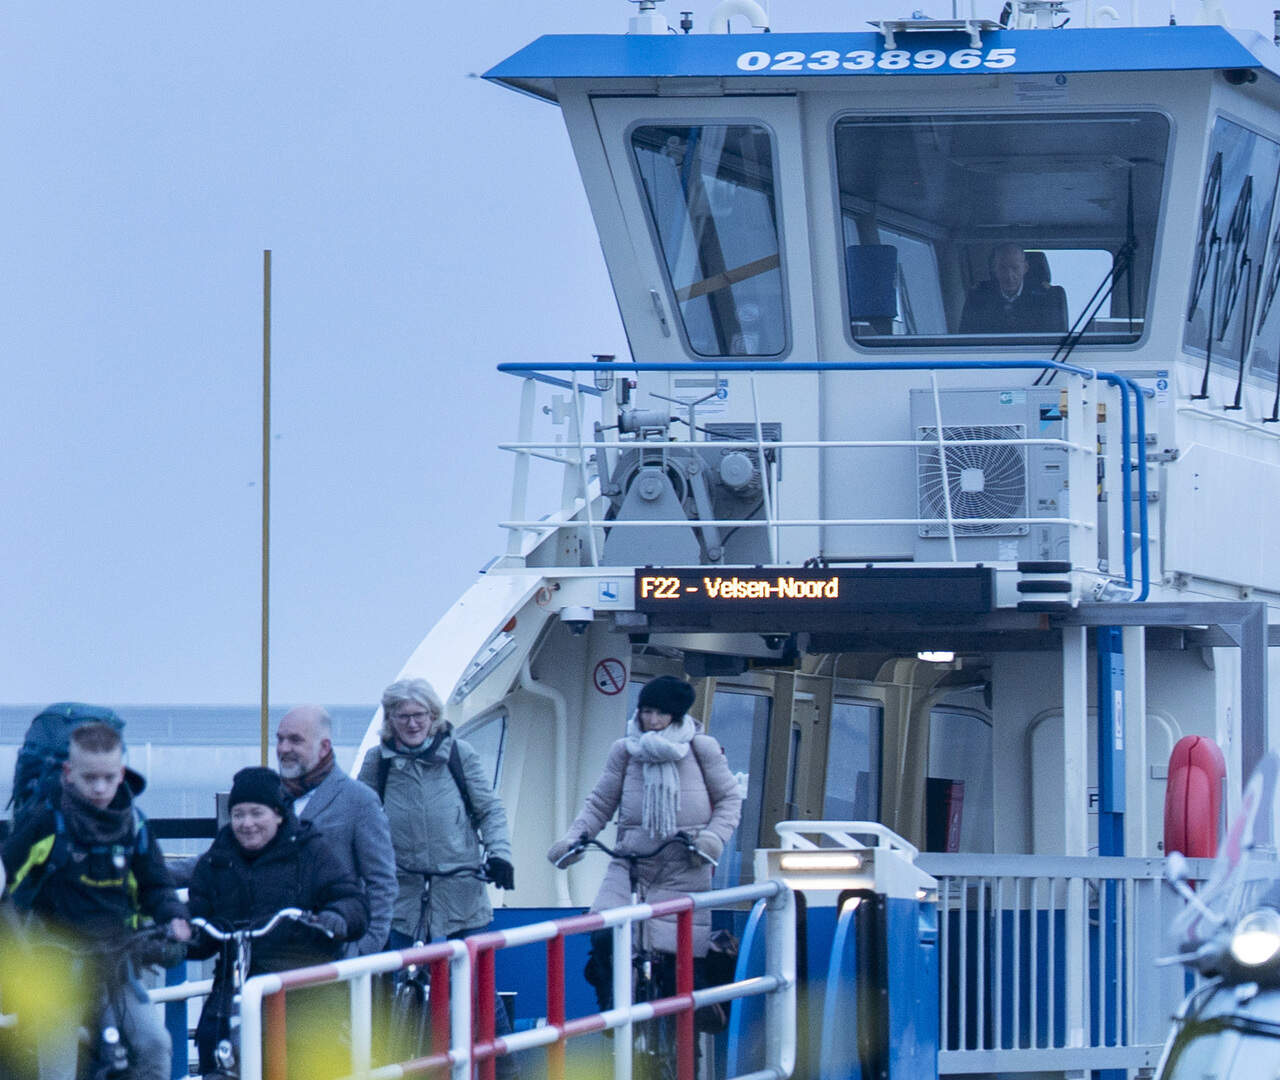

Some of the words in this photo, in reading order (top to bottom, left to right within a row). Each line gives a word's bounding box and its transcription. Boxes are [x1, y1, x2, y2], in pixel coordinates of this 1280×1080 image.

[736, 48, 1016, 71] 02338965
[640, 577, 681, 598] F22
[704, 577, 839, 598] Velsen-Noord
